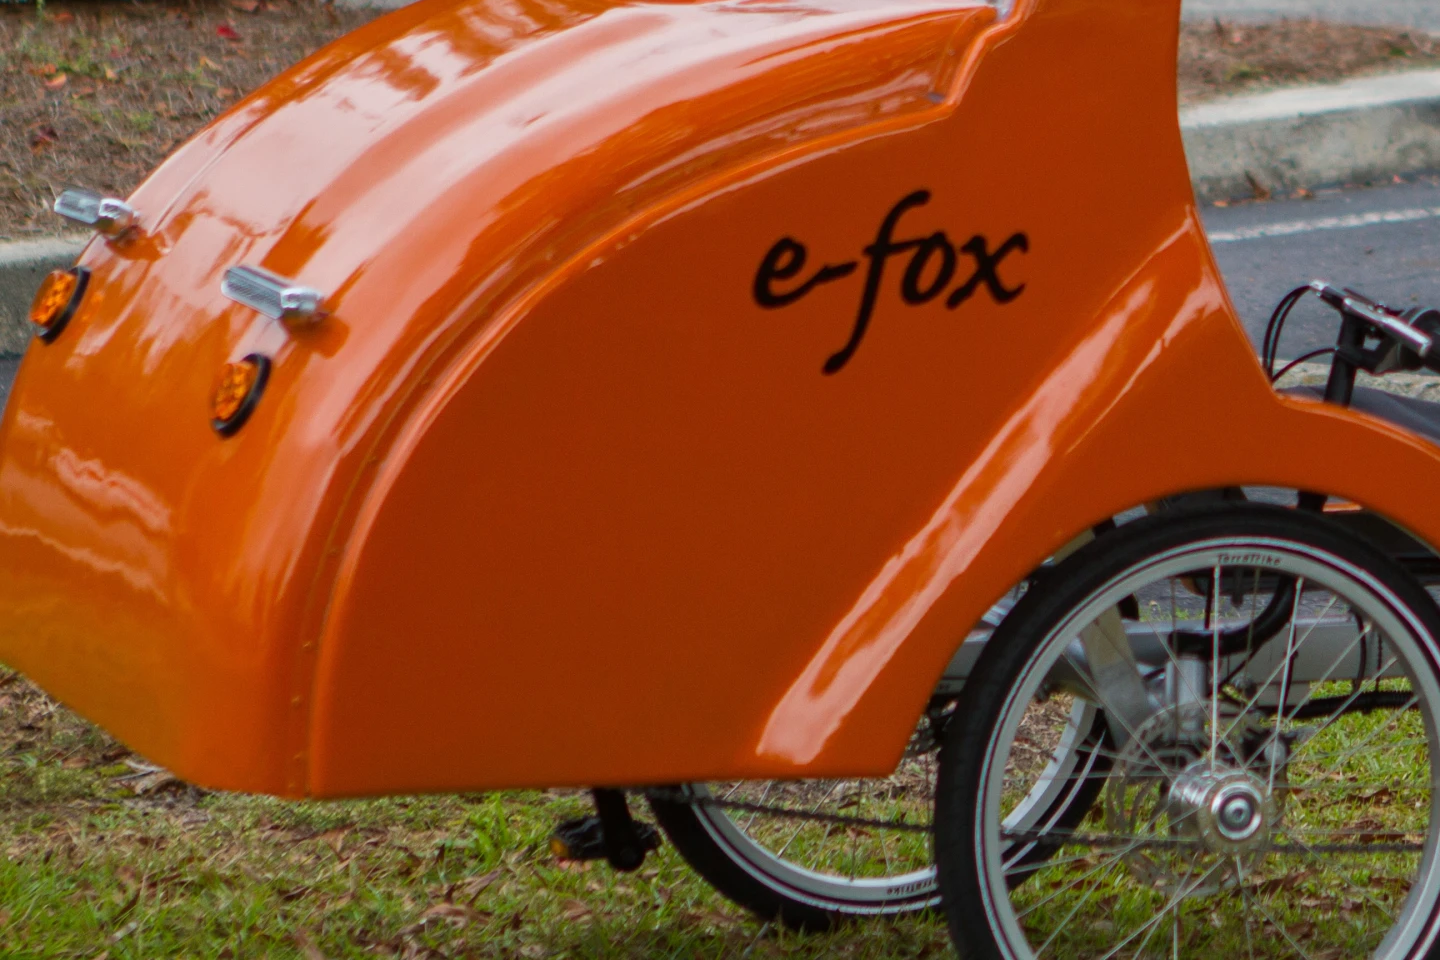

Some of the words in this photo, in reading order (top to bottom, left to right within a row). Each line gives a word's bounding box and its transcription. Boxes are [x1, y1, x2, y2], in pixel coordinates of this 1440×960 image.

[752, 187, 1029, 376] e-fox
[1216, 553, 1281, 567] TerraTrike
[886, 879, 933, 896] rraTrike
